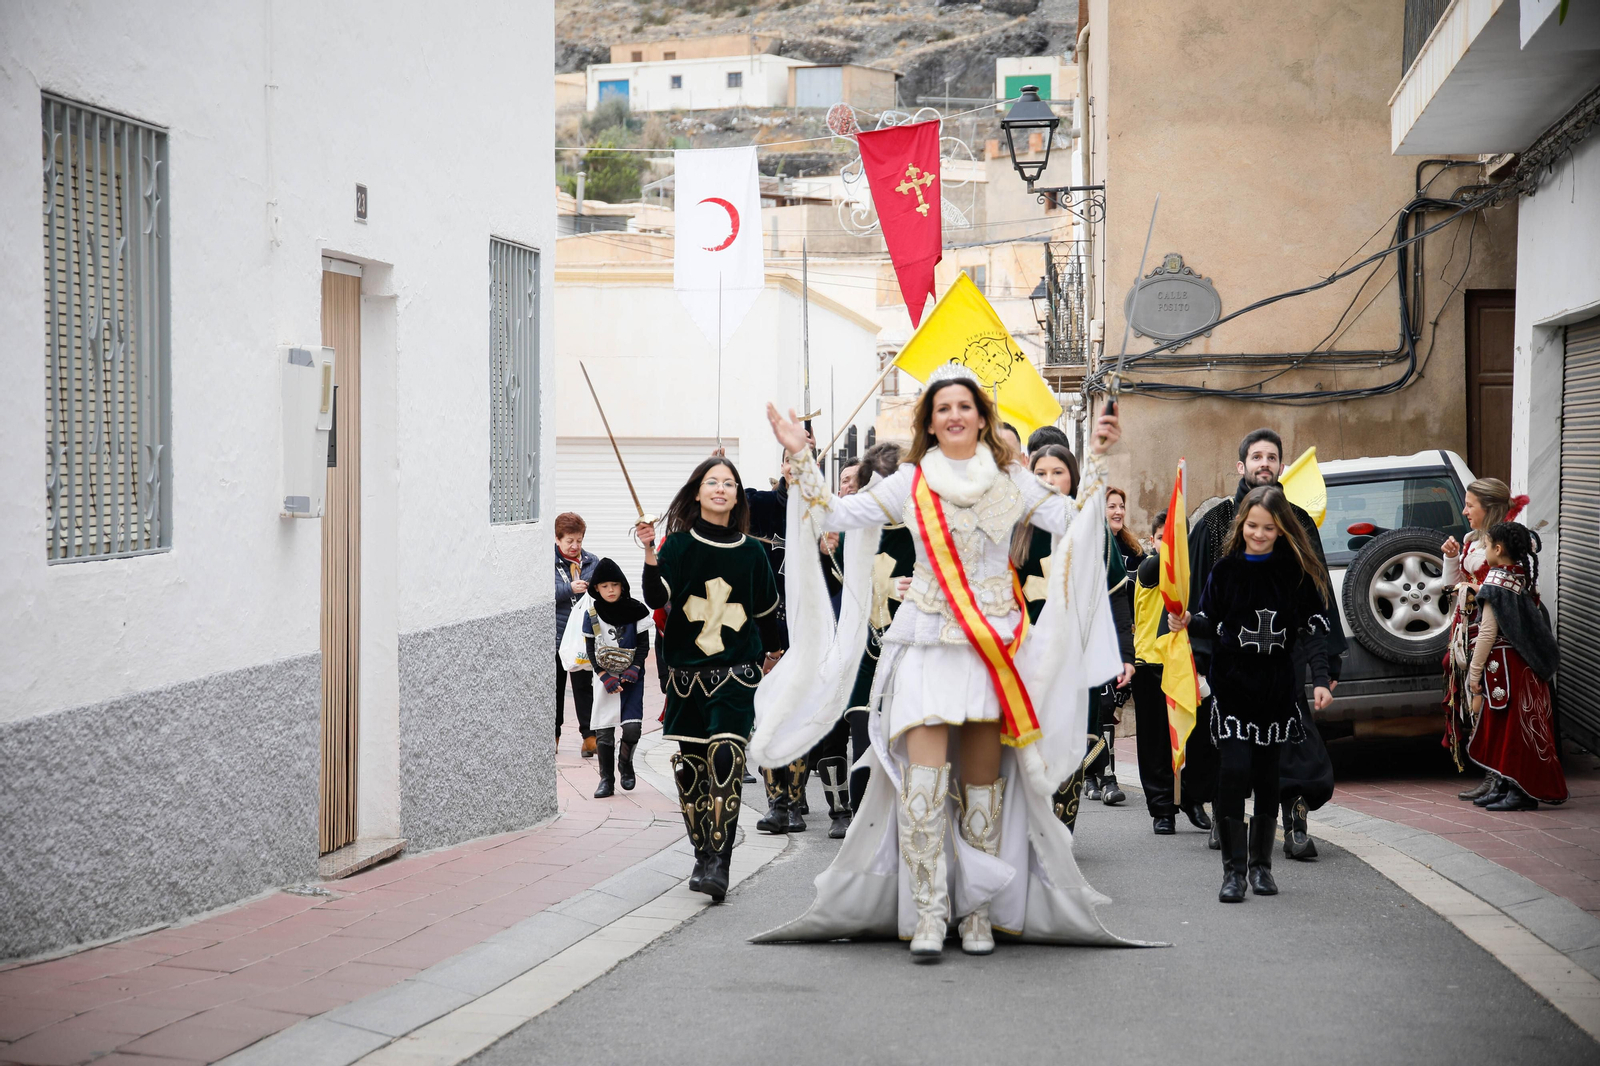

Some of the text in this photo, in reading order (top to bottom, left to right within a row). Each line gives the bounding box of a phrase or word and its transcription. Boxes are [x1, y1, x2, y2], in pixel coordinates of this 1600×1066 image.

[357, 192, 366, 213] 23
[1157, 291, 1188, 300] CALLE
[1157, 303, 1190, 312] POSITO
